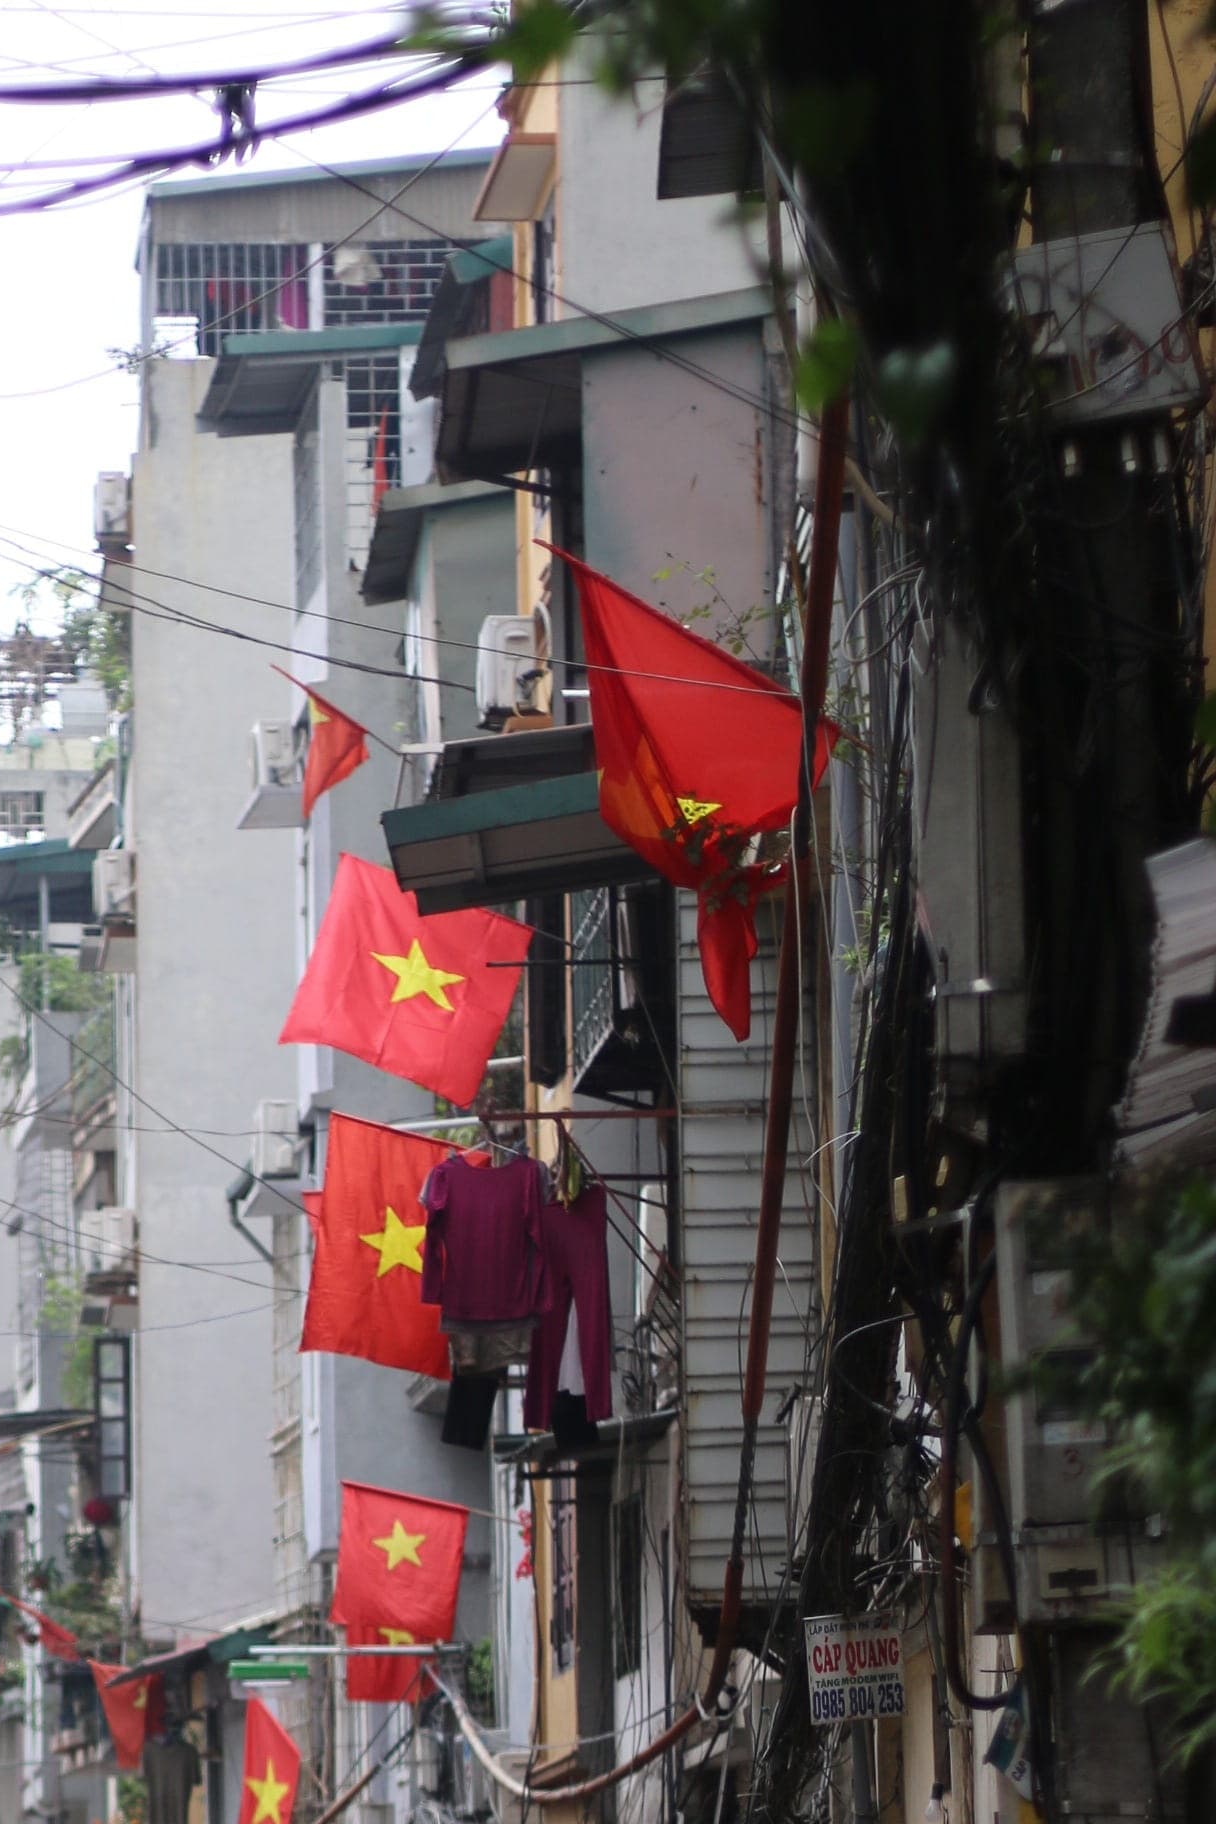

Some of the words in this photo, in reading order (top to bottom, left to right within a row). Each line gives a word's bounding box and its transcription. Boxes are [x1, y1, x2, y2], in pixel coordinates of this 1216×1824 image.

[812, 1636, 842, 1674] CÁP
[845, 1637, 899, 1676] QUANG
[879, 1672, 899, 1682] WIFI
[813, 1688, 845, 1720] 0985
[849, 1685, 875, 1717] 804
[878, 1682, 904, 1714] 253
